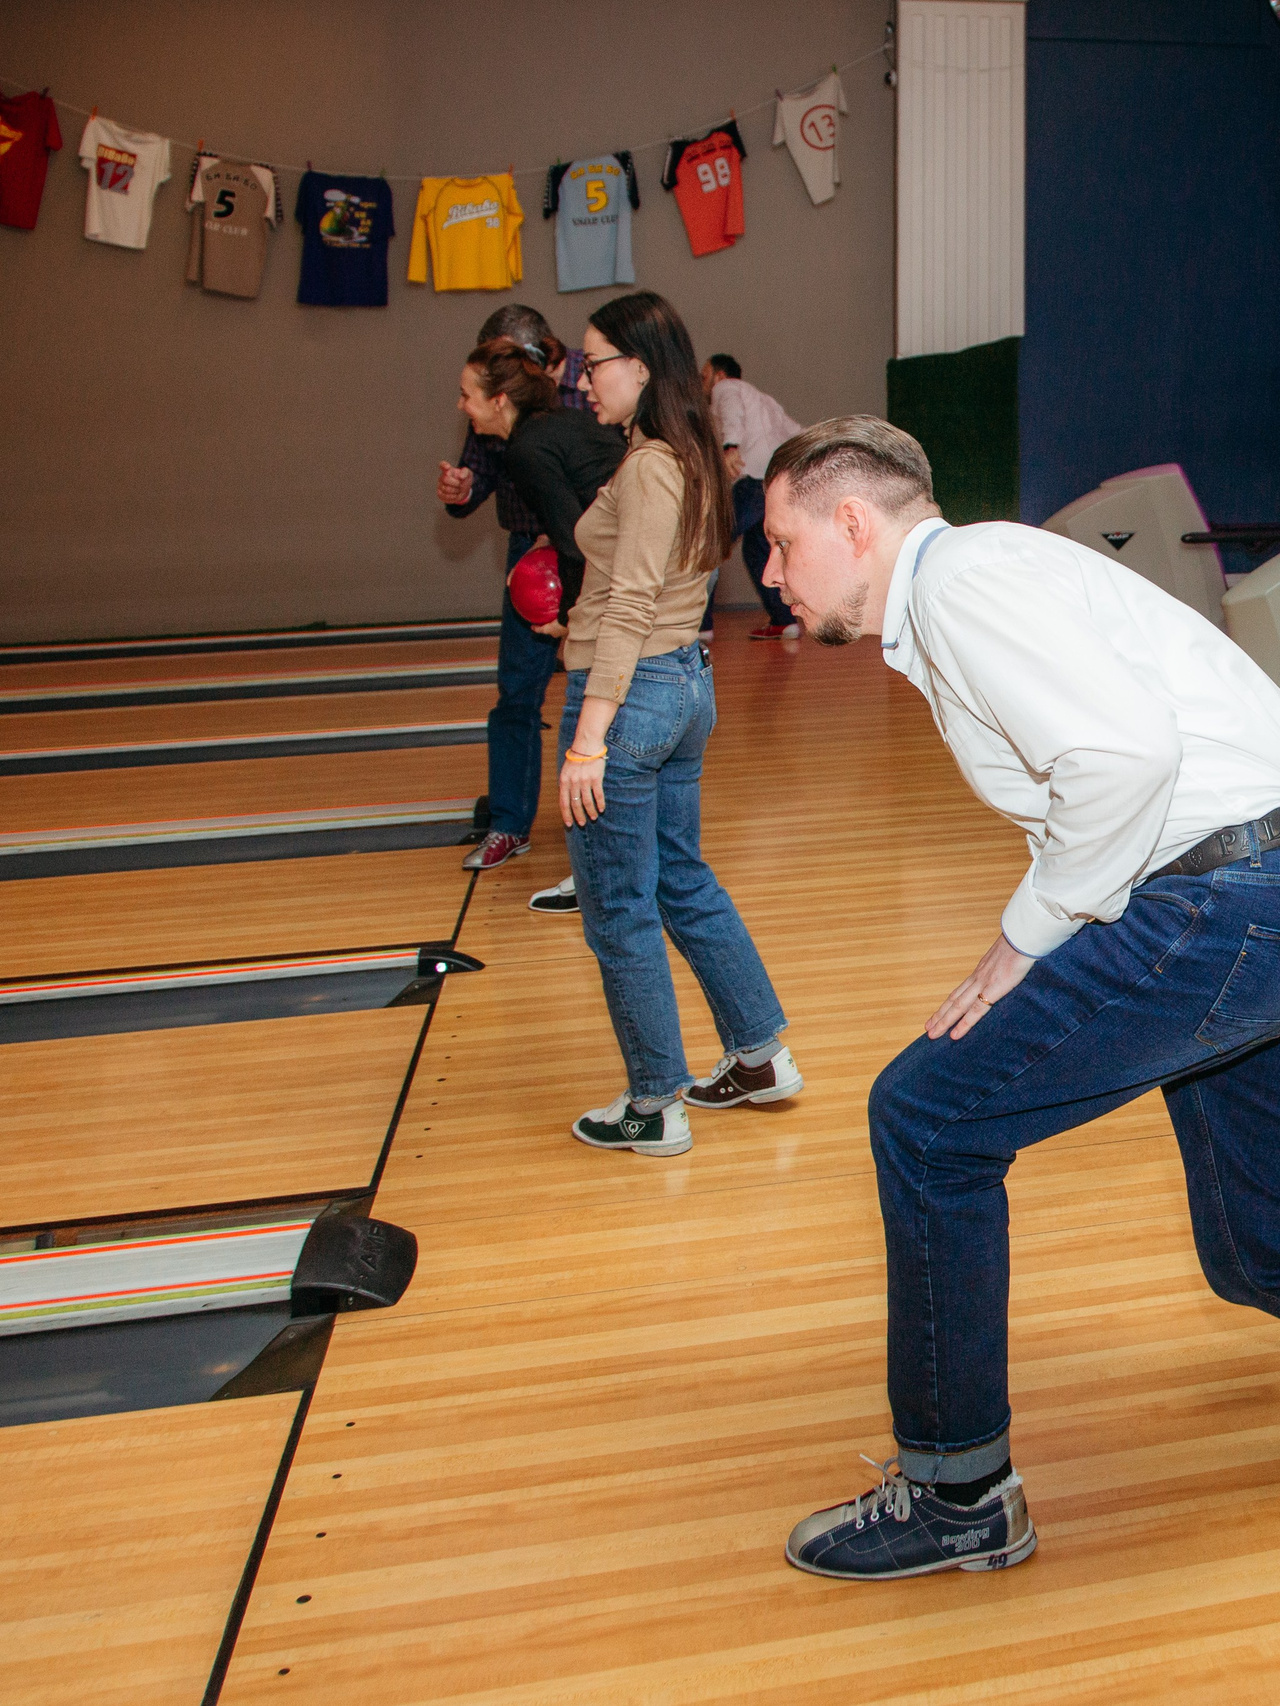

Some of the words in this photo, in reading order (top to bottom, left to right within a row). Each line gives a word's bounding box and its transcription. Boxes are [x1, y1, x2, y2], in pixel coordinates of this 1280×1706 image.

[100, 161, 135, 195] 12
[697, 157, 731, 194] 98
[214, 189, 236, 219] 5
[586, 179, 609, 213] 5
[941, 1526, 990, 1547] Bowling
